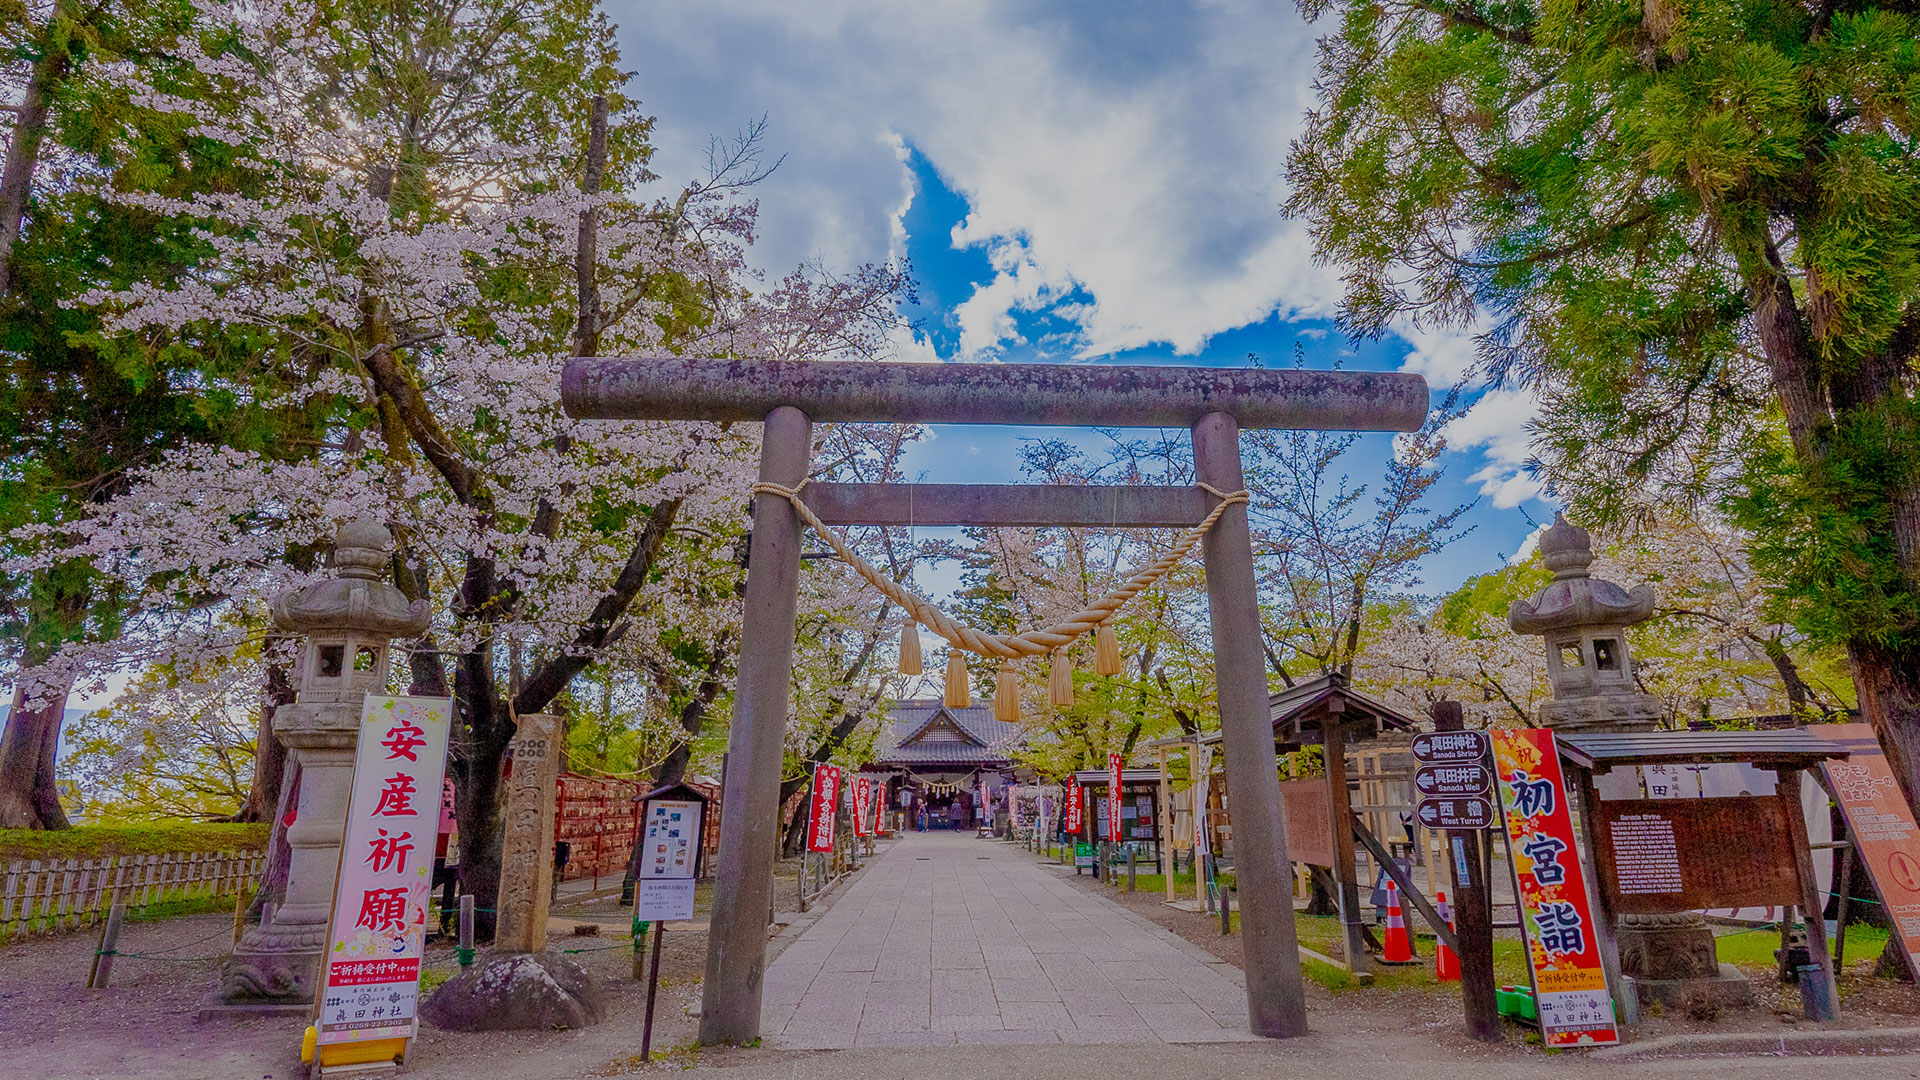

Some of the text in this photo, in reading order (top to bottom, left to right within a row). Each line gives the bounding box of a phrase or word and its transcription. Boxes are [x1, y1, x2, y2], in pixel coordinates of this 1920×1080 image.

[1430, 734, 1478, 751] 真田神社
[1432, 750, 1479, 759] Sanada Shrine
[1515, 745, 1536, 765] 祝
[1434, 767, 1481, 784] 真田井戸
[1831, 766, 1869, 777] ポケモン
[1438, 784, 1464, 792] Sanada
[1838, 776, 1894, 789] トレーナーの
[354, 719, 428, 933] 安産祈願
[1441, 817, 1483, 825] West Turret
[1512, 769, 1585, 954] 初宮詣
